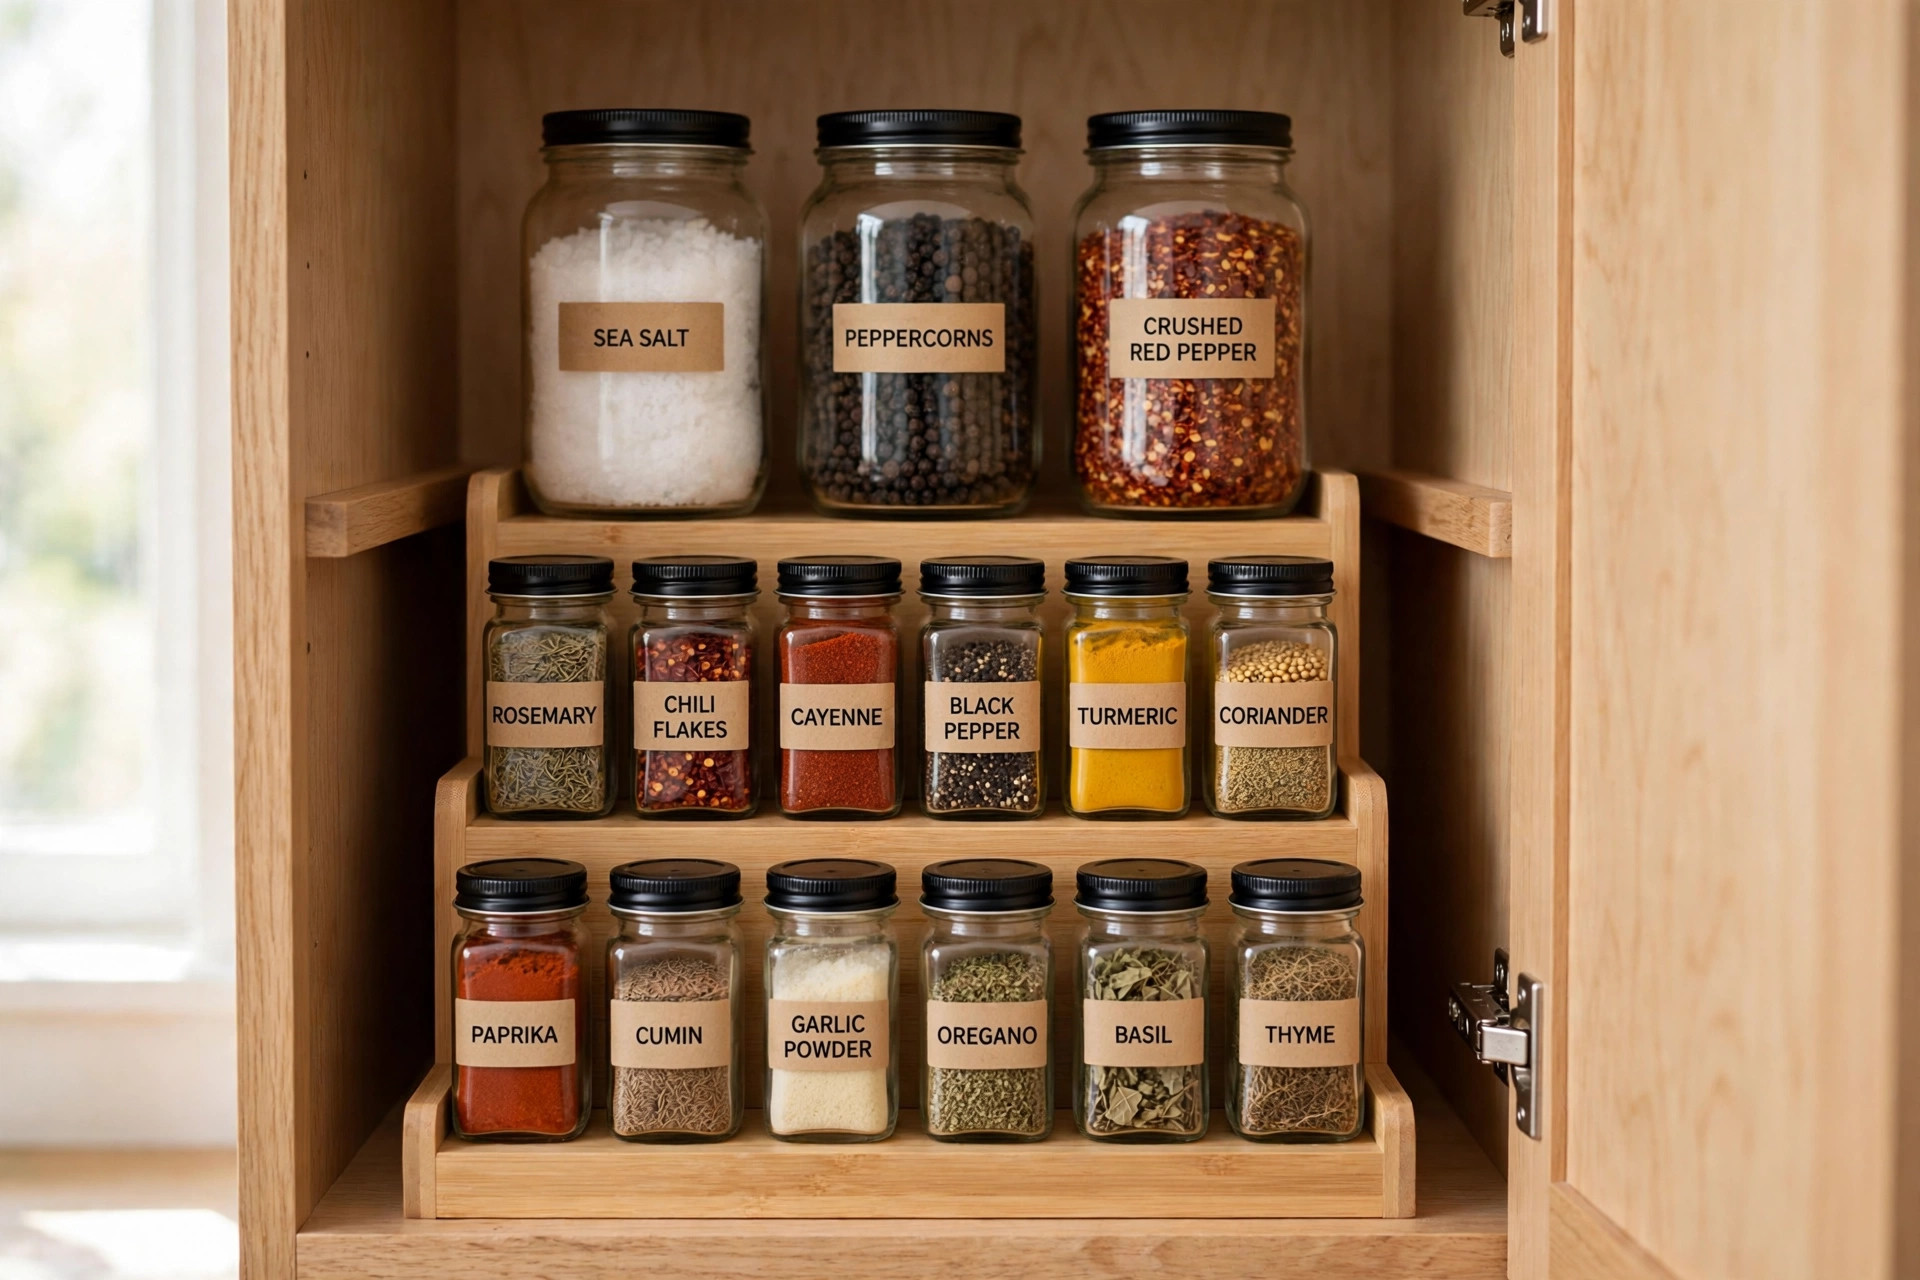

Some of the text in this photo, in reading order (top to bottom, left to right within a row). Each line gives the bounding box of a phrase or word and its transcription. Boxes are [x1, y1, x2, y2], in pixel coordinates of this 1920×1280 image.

[1143, 316, 1243, 336] CRUSHED
[592, 328, 690, 349] SEA SALT
[845, 328, 994, 348] PEPPERCORNS
[1130, 342, 1257, 362] RED PEPPER
[664, 695, 715, 714] CHILI
[950, 696, 1015, 715] BLACK
[491, 705, 598, 725] ROSEMARY
[791, 707, 883, 727] CAYENNE
[1077, 706, 1178, 726] TURMERIC
[1219, 705, 1329, 725] CORIANDER
[653, 720, 728, 739] FLAKES
[944, 721, 1021, 740] PEPPER
[791, 1014, 866, 1034] GARLIC
[471, 1025, 559, 1044] PAPRIKA
[635, 1025, 703, 1045] CUMIN
[937, 1025, 1038, 1046] OREGANO
[1115, 1025, 1173, 1045] BASIL
[1264, 1025, 1336, 1044] THYME
[784, 1039, 873, 1059] POWDER
